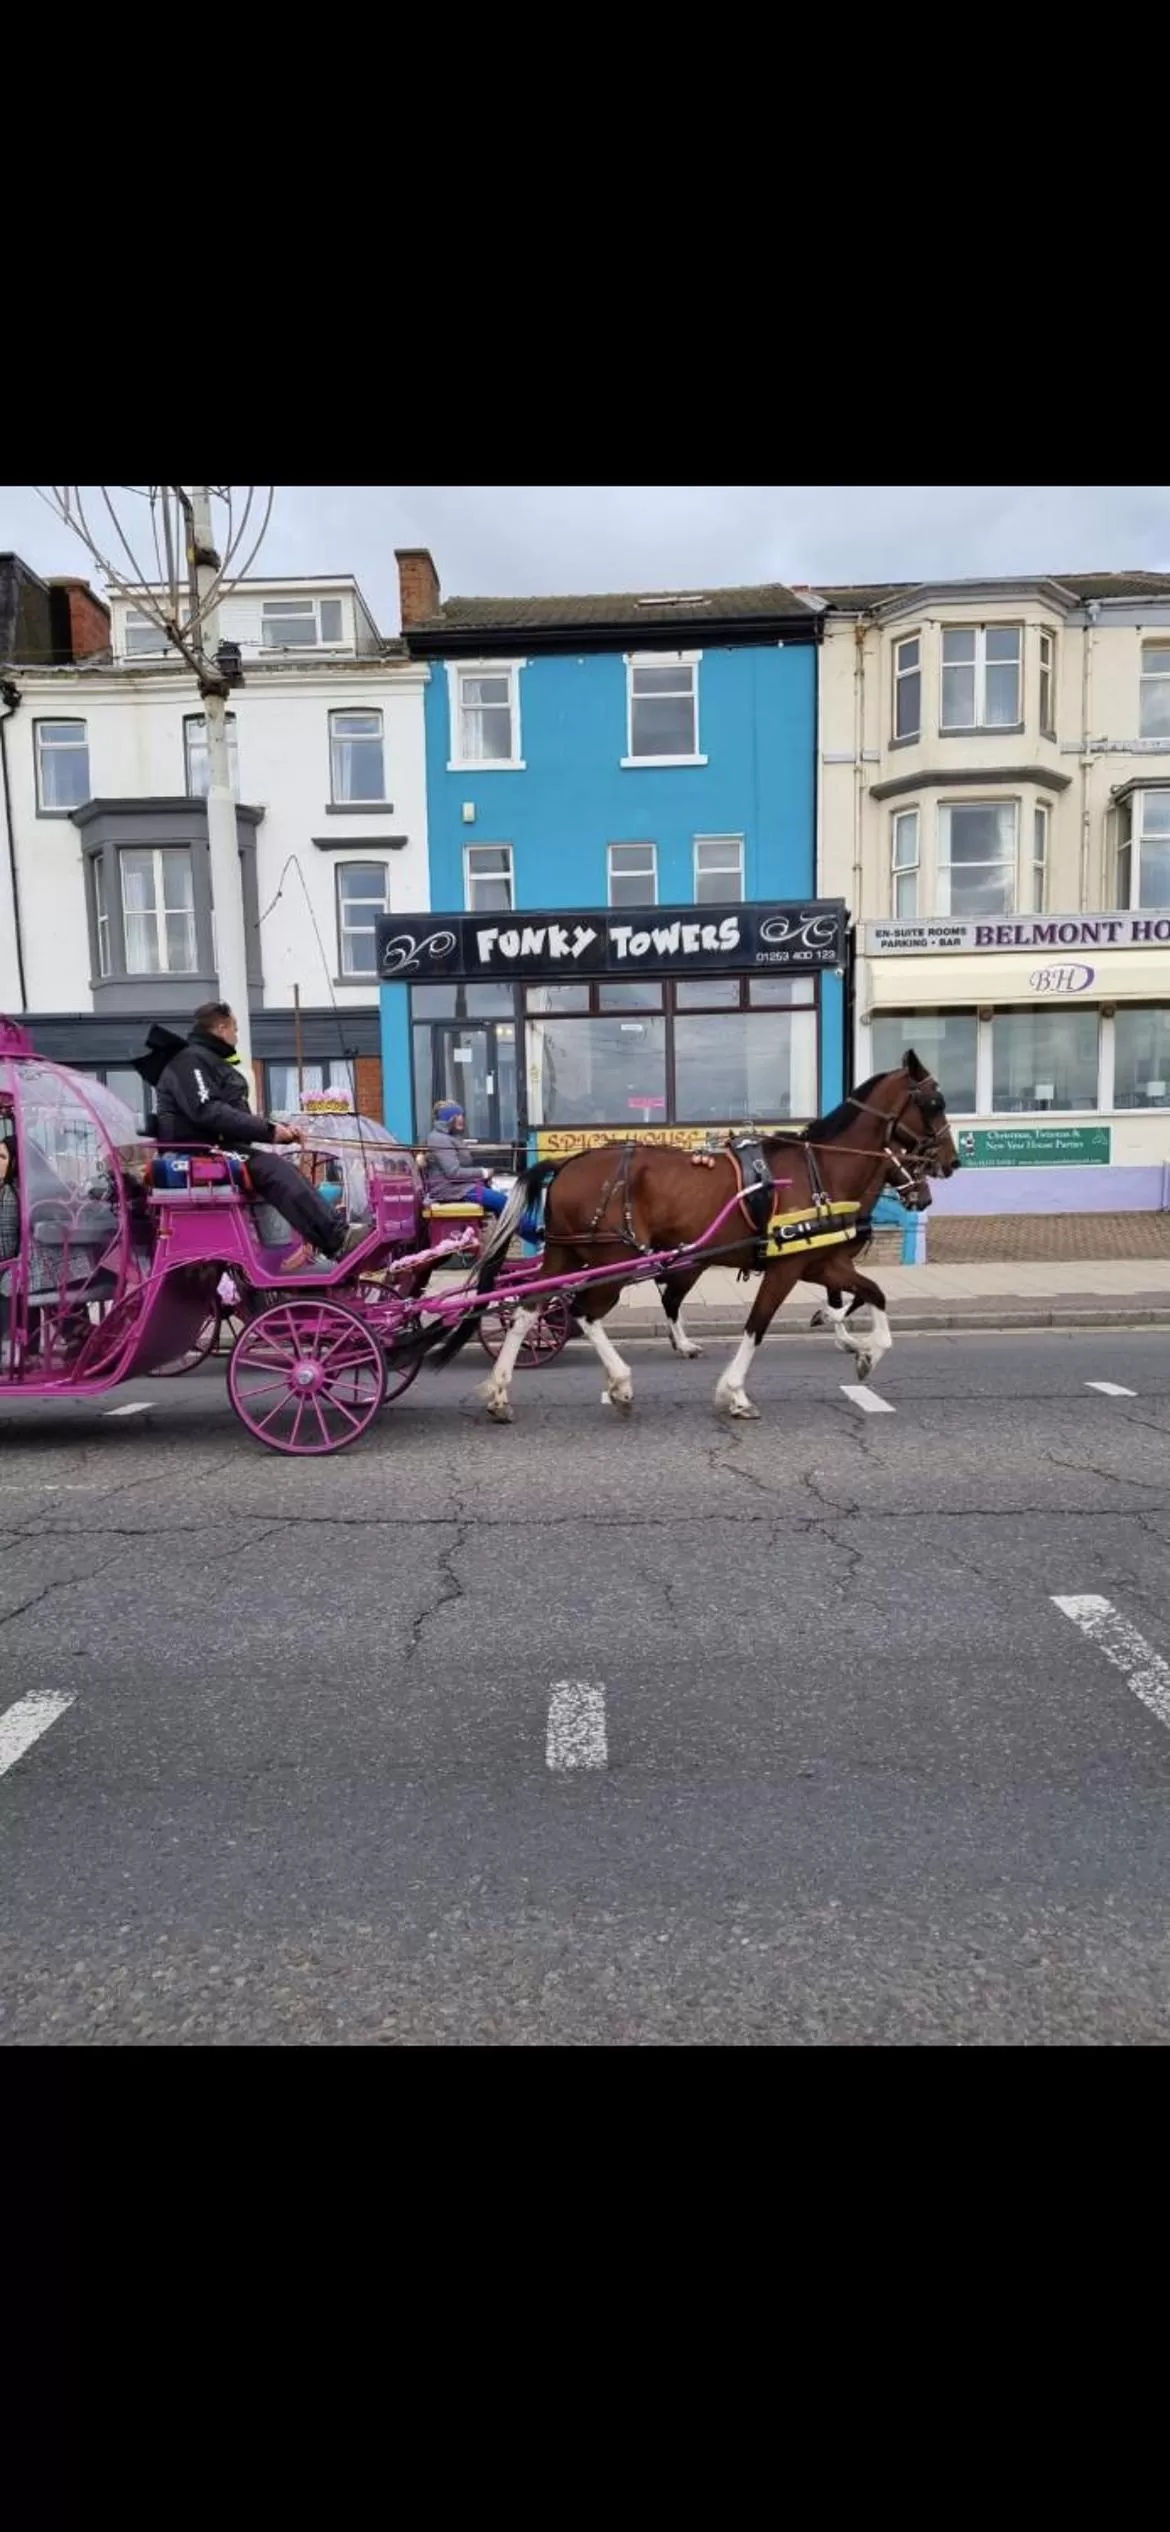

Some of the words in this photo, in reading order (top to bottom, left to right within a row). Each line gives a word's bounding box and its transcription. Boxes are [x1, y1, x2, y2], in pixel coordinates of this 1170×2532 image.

[875, 928, 925, 938] EN-SUITE
[928, 926, 967, 936] ROOMS
[974, 921, 1123, 946] BELMONT
[476, 923, 598, 963] FUNKY
[609, 916, 741, 959] TOWERS
[881, 939, 928, 948] PARKING
[939, 938, 961, 946] BAR
[755, 951, 790, 962] 01253
[792, 951, 813, 960] 400
[815, 949, 836, 961] 123
